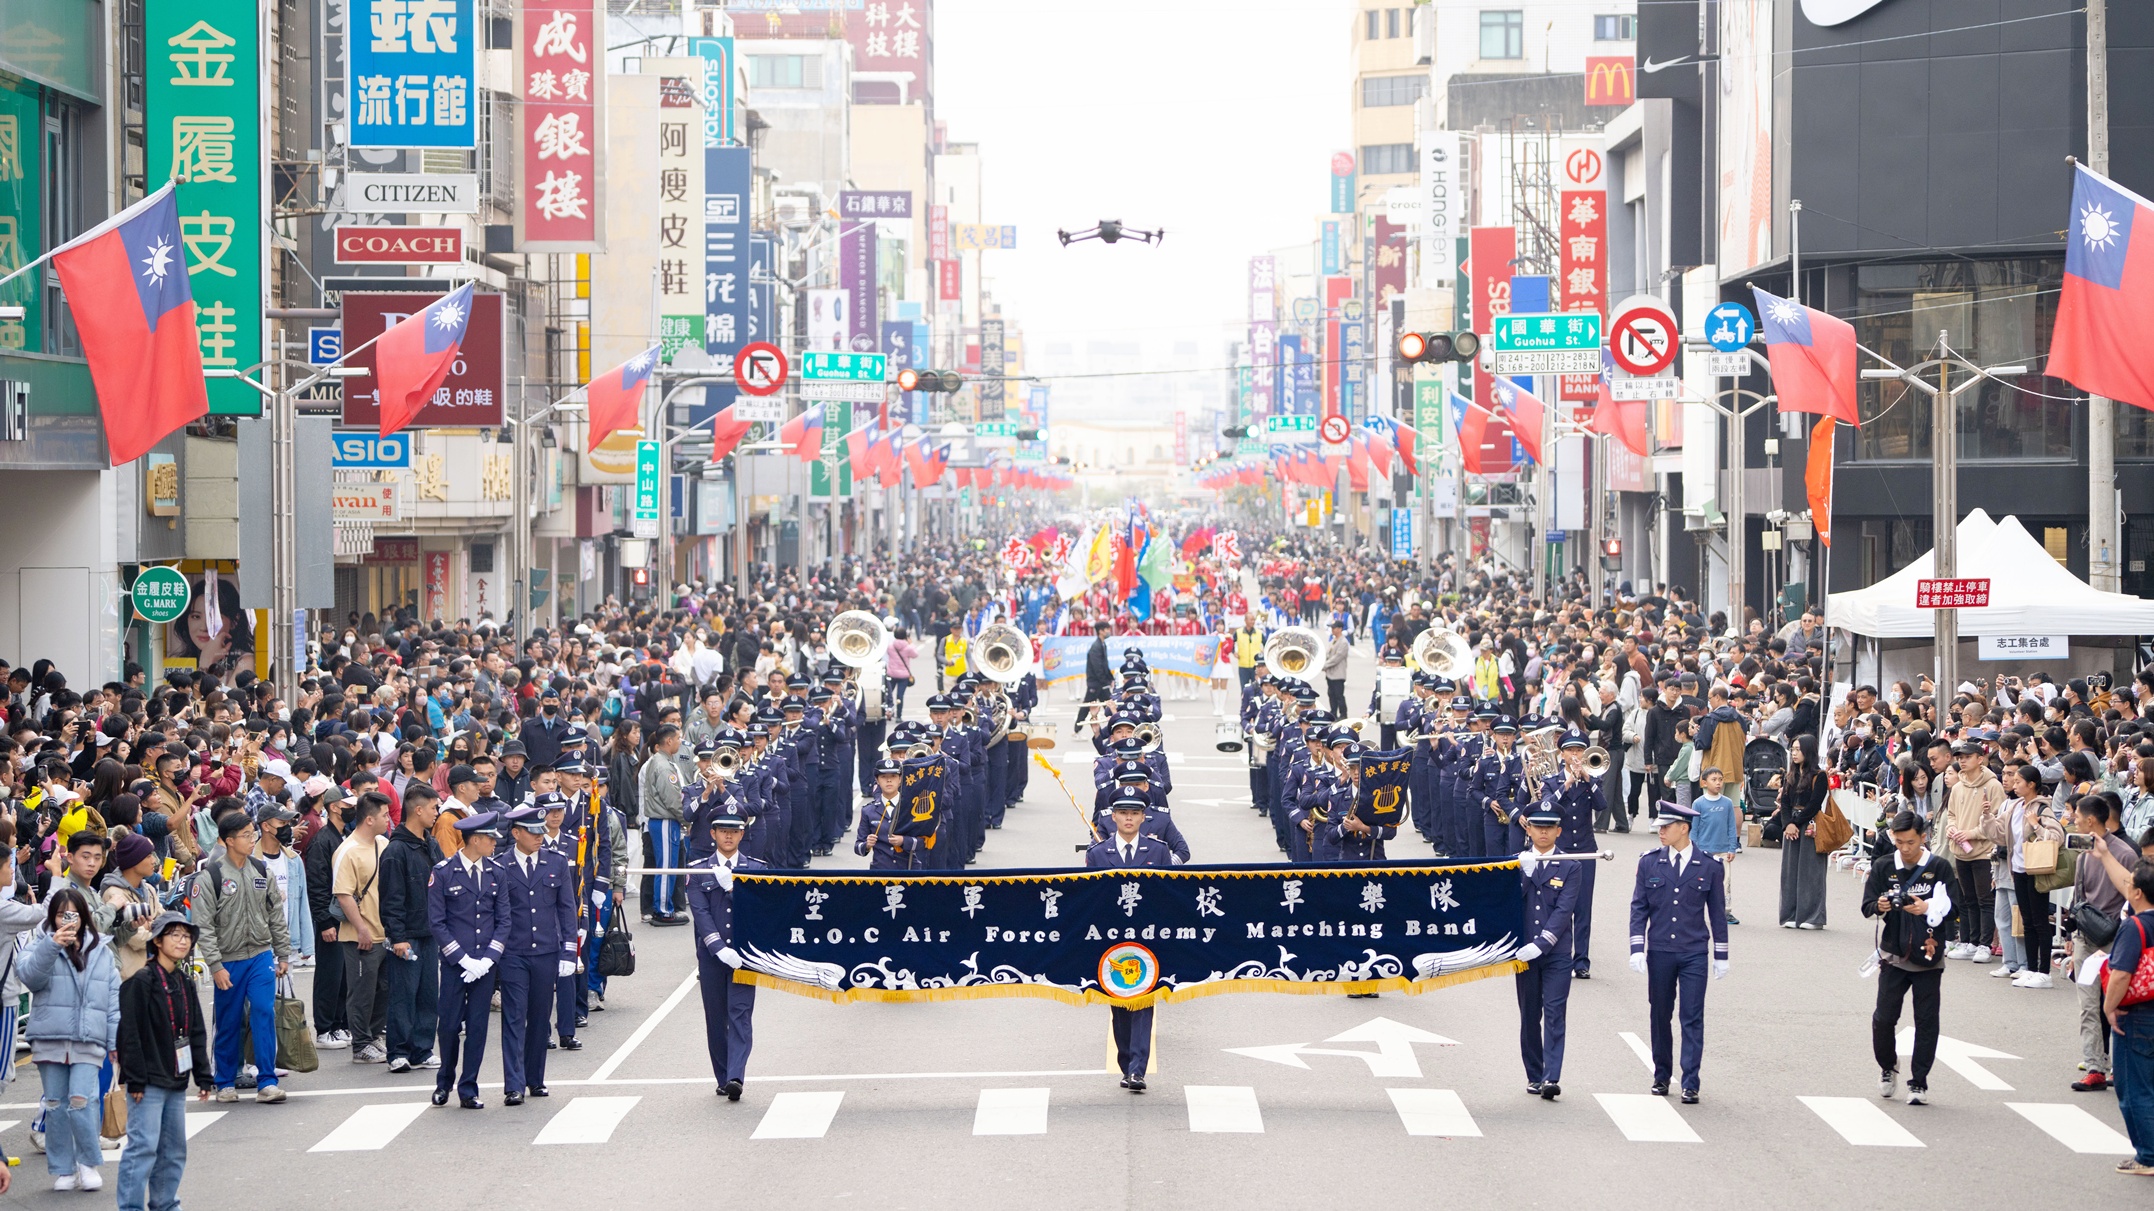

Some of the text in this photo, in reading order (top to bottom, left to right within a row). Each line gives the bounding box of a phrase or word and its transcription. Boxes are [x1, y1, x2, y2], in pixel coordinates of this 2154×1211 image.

[529, 68, 590, 101] 珠寶
[357, 75, 467, 126] 流行館
[364, 184, 457, 202] CITIZEN
[661, 122, 689, 295] 阿瘦皮鞋
[342, 237, 456, 253] COACH
[660, 317, 691, 337] 健康
[1511, 318, 1583, 335] 國華街
[1514, 336, 1581, 347] Guohua St.
[6, 381, 31, 440] NET
[640, 461, 655, 508] 中山路
[137, 581, 184, 597] 金履皮鞋
[1919, 581, 1988, 594] 騎樓禁止停車
[144, 599, 177, 608] G.MARK
[1918, 594, 1987, 606] 違者加強取締
[152, 609, 169, 617] shoes
[1996, 637, 2050, 648] 志工集合處
[790, 918, 1477, 944] R.O.C Air Force Academy Marching Band
